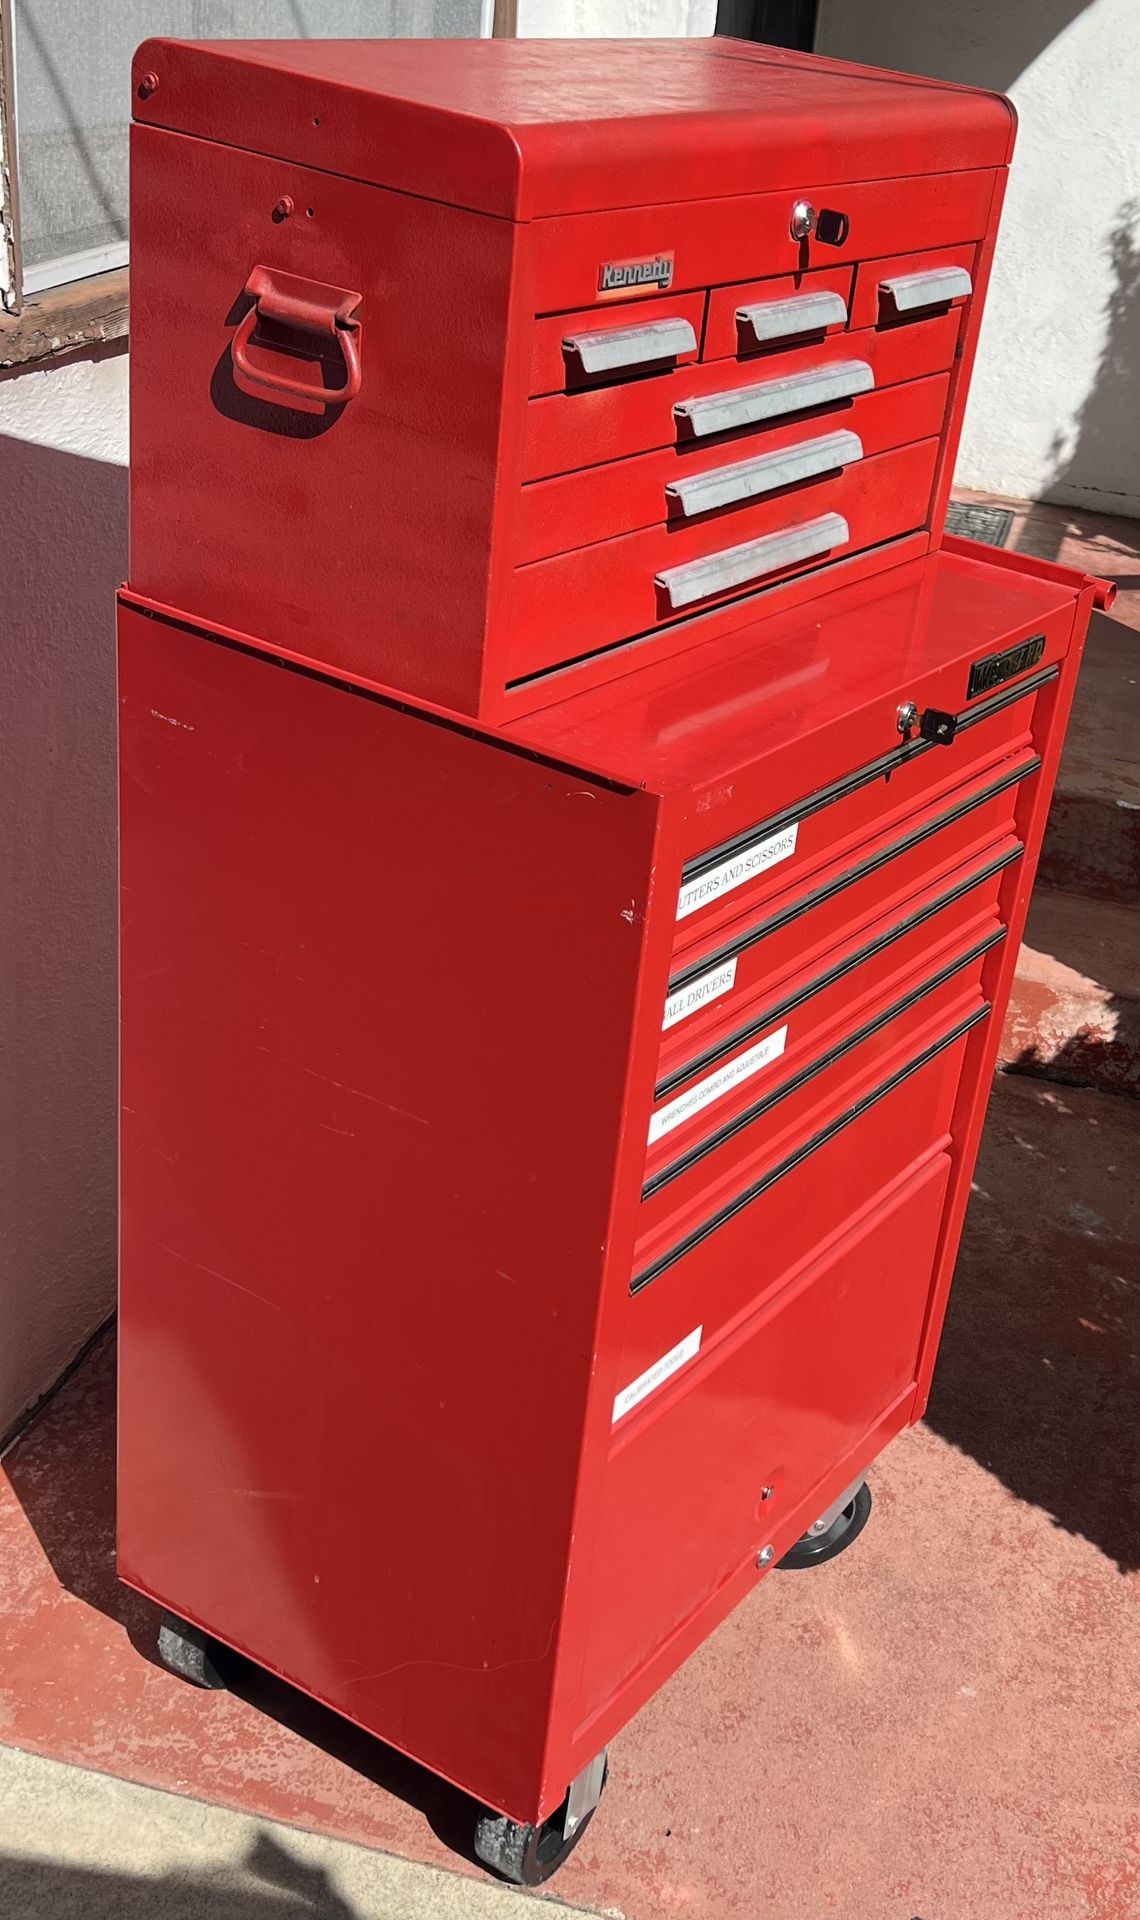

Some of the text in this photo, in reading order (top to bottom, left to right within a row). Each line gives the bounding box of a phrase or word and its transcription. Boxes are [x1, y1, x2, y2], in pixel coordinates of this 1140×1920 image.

[600, 256, 673, 290] Kennedy
[721, 863, 744, 886] AND
[745, 834, 794, 873] SCISSORS
[686, 969, 732, 1007] DRIVERS
[698, 1079, 722, 1101] COMBO
[721, 1069, 735, 1084] AND
